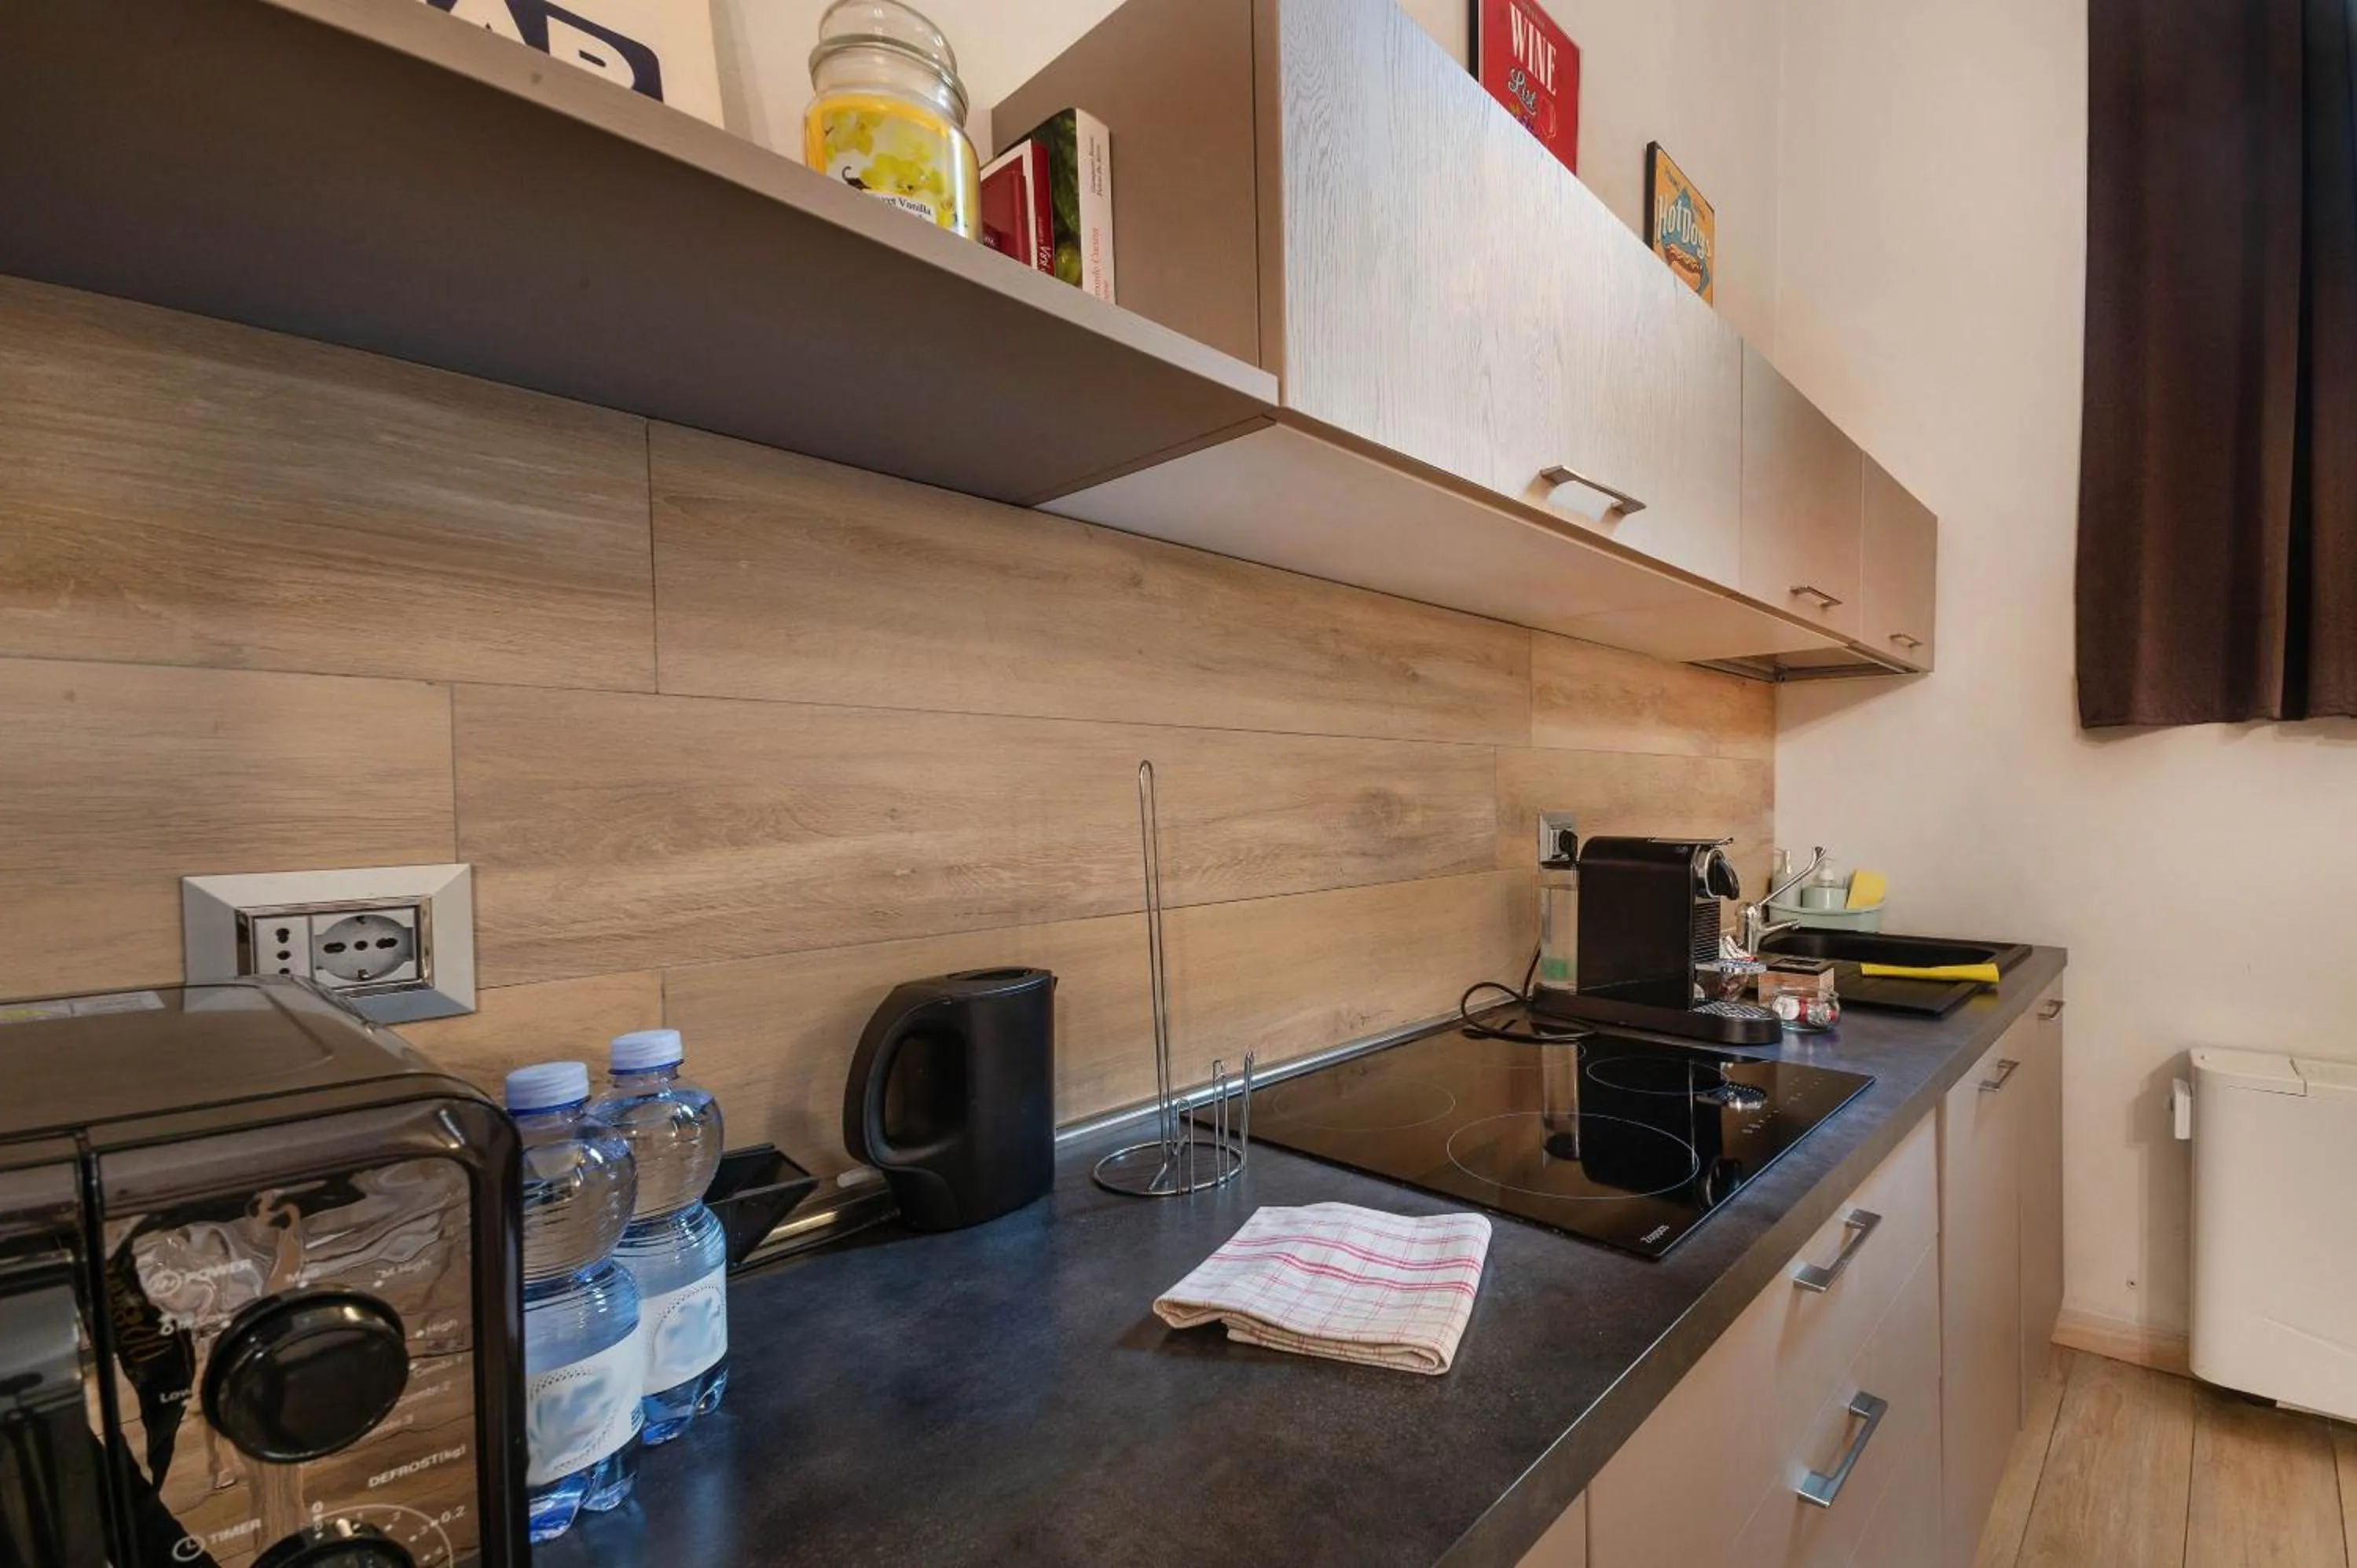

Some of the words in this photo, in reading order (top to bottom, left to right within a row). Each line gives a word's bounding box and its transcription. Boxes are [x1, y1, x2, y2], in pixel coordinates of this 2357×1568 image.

[1509, 1, 1557, 96] WINE
[898, 197, 932, 216] Vanilla
[185, 1259, 253, 1283] POWER
[440, 1504, 467, 1523] 0.2
[208, 1517, 262, 1545] TIMER
